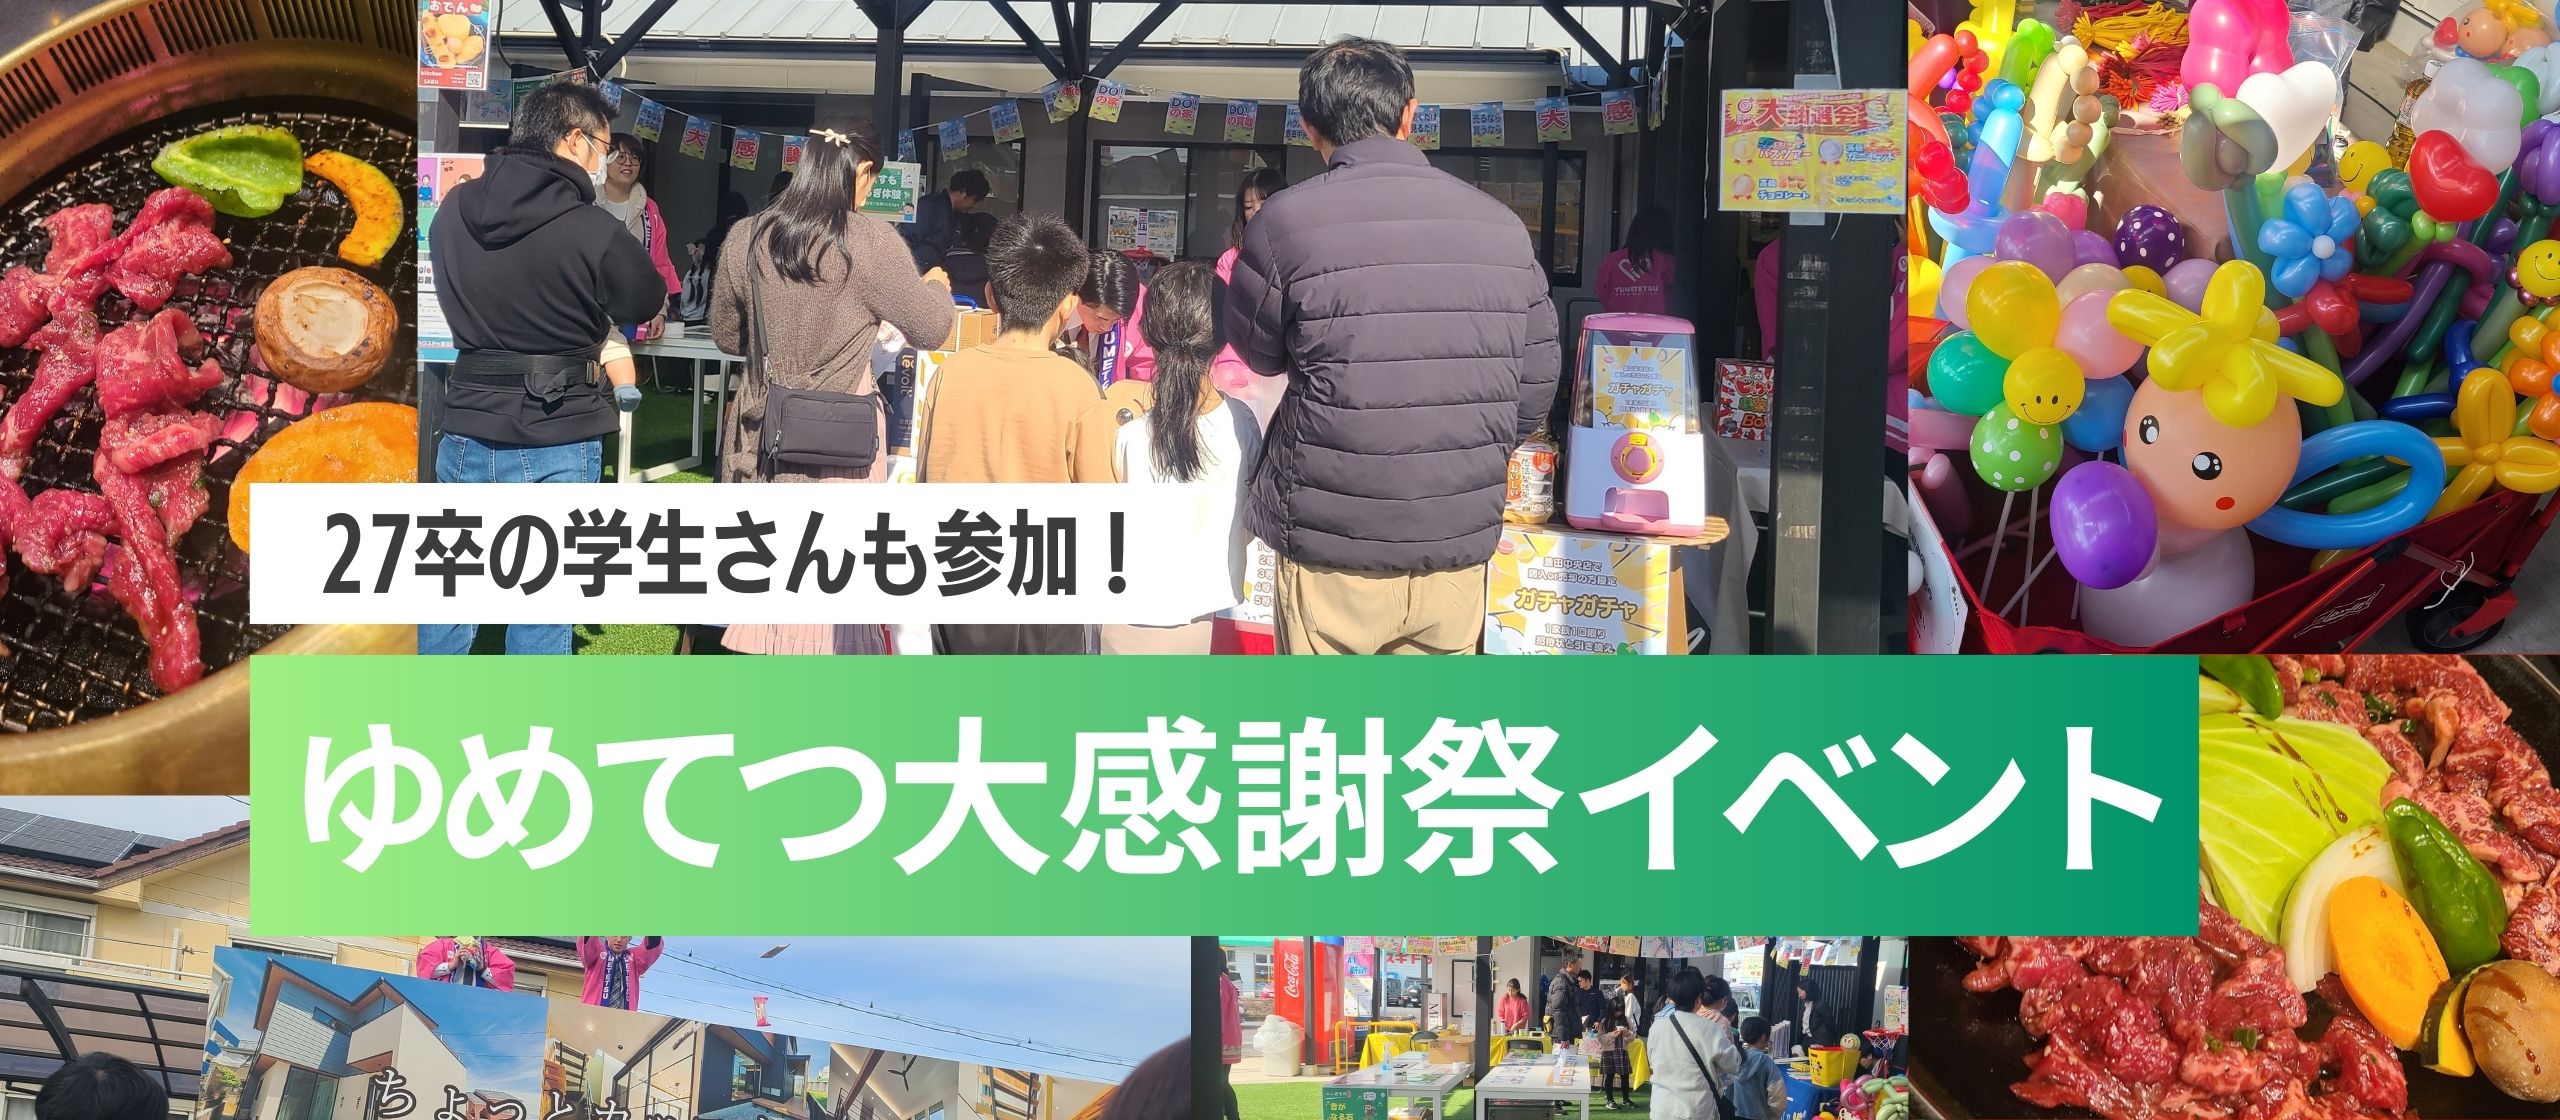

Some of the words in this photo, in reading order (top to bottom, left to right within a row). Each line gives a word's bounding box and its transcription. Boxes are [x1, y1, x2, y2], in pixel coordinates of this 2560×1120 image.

[429, 0, 469, 13] おでん
[1099, 85, 1124, 98] DO!
[1171, 97, 1197, 109] DO!
[1229, 105, 1248, 116] DO!
[1603, 100, 1636, 123] 感
[1537, 107, 1569, 132] 大
[683, 127, 710, 148] 大
[733, 138, 759, 159] 感
[1757, 190, 1810, 200] チョコレート
[1614, 285, 1659, 293] YUMETETSU
[1607, 382, 1673, 397] ガチャガチャ
[1509, 464, 1520, 497] おいしい
[1543, 556, 1603, 572] 豊田中央店で
[1513, 587, 1638, 621] ガチャガチャ
